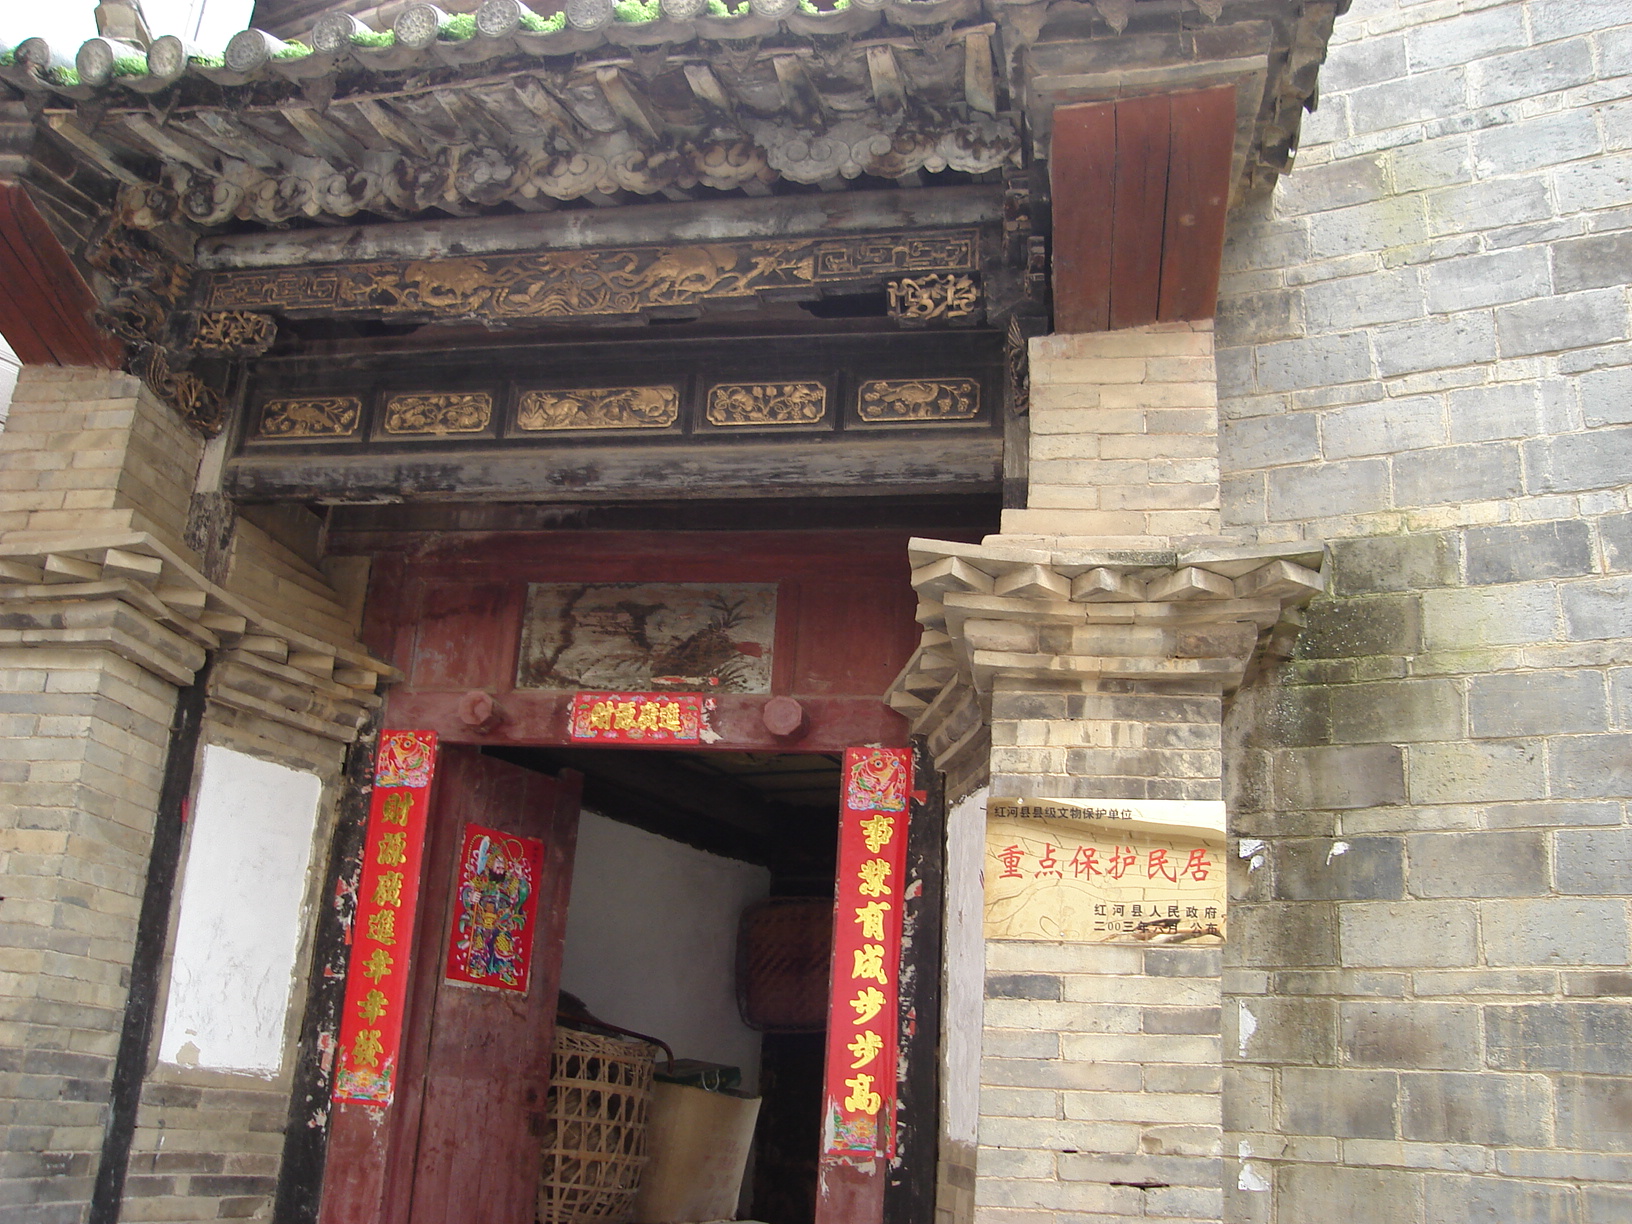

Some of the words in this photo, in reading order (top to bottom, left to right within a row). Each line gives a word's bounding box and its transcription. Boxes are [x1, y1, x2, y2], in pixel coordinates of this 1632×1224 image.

[994, 806, 1133, 820] 红河县县级文物保护单位
[997, 843, 1212, 883] 重点保护民居
[1094, 904, 1218, 918] 红河县人民政府
